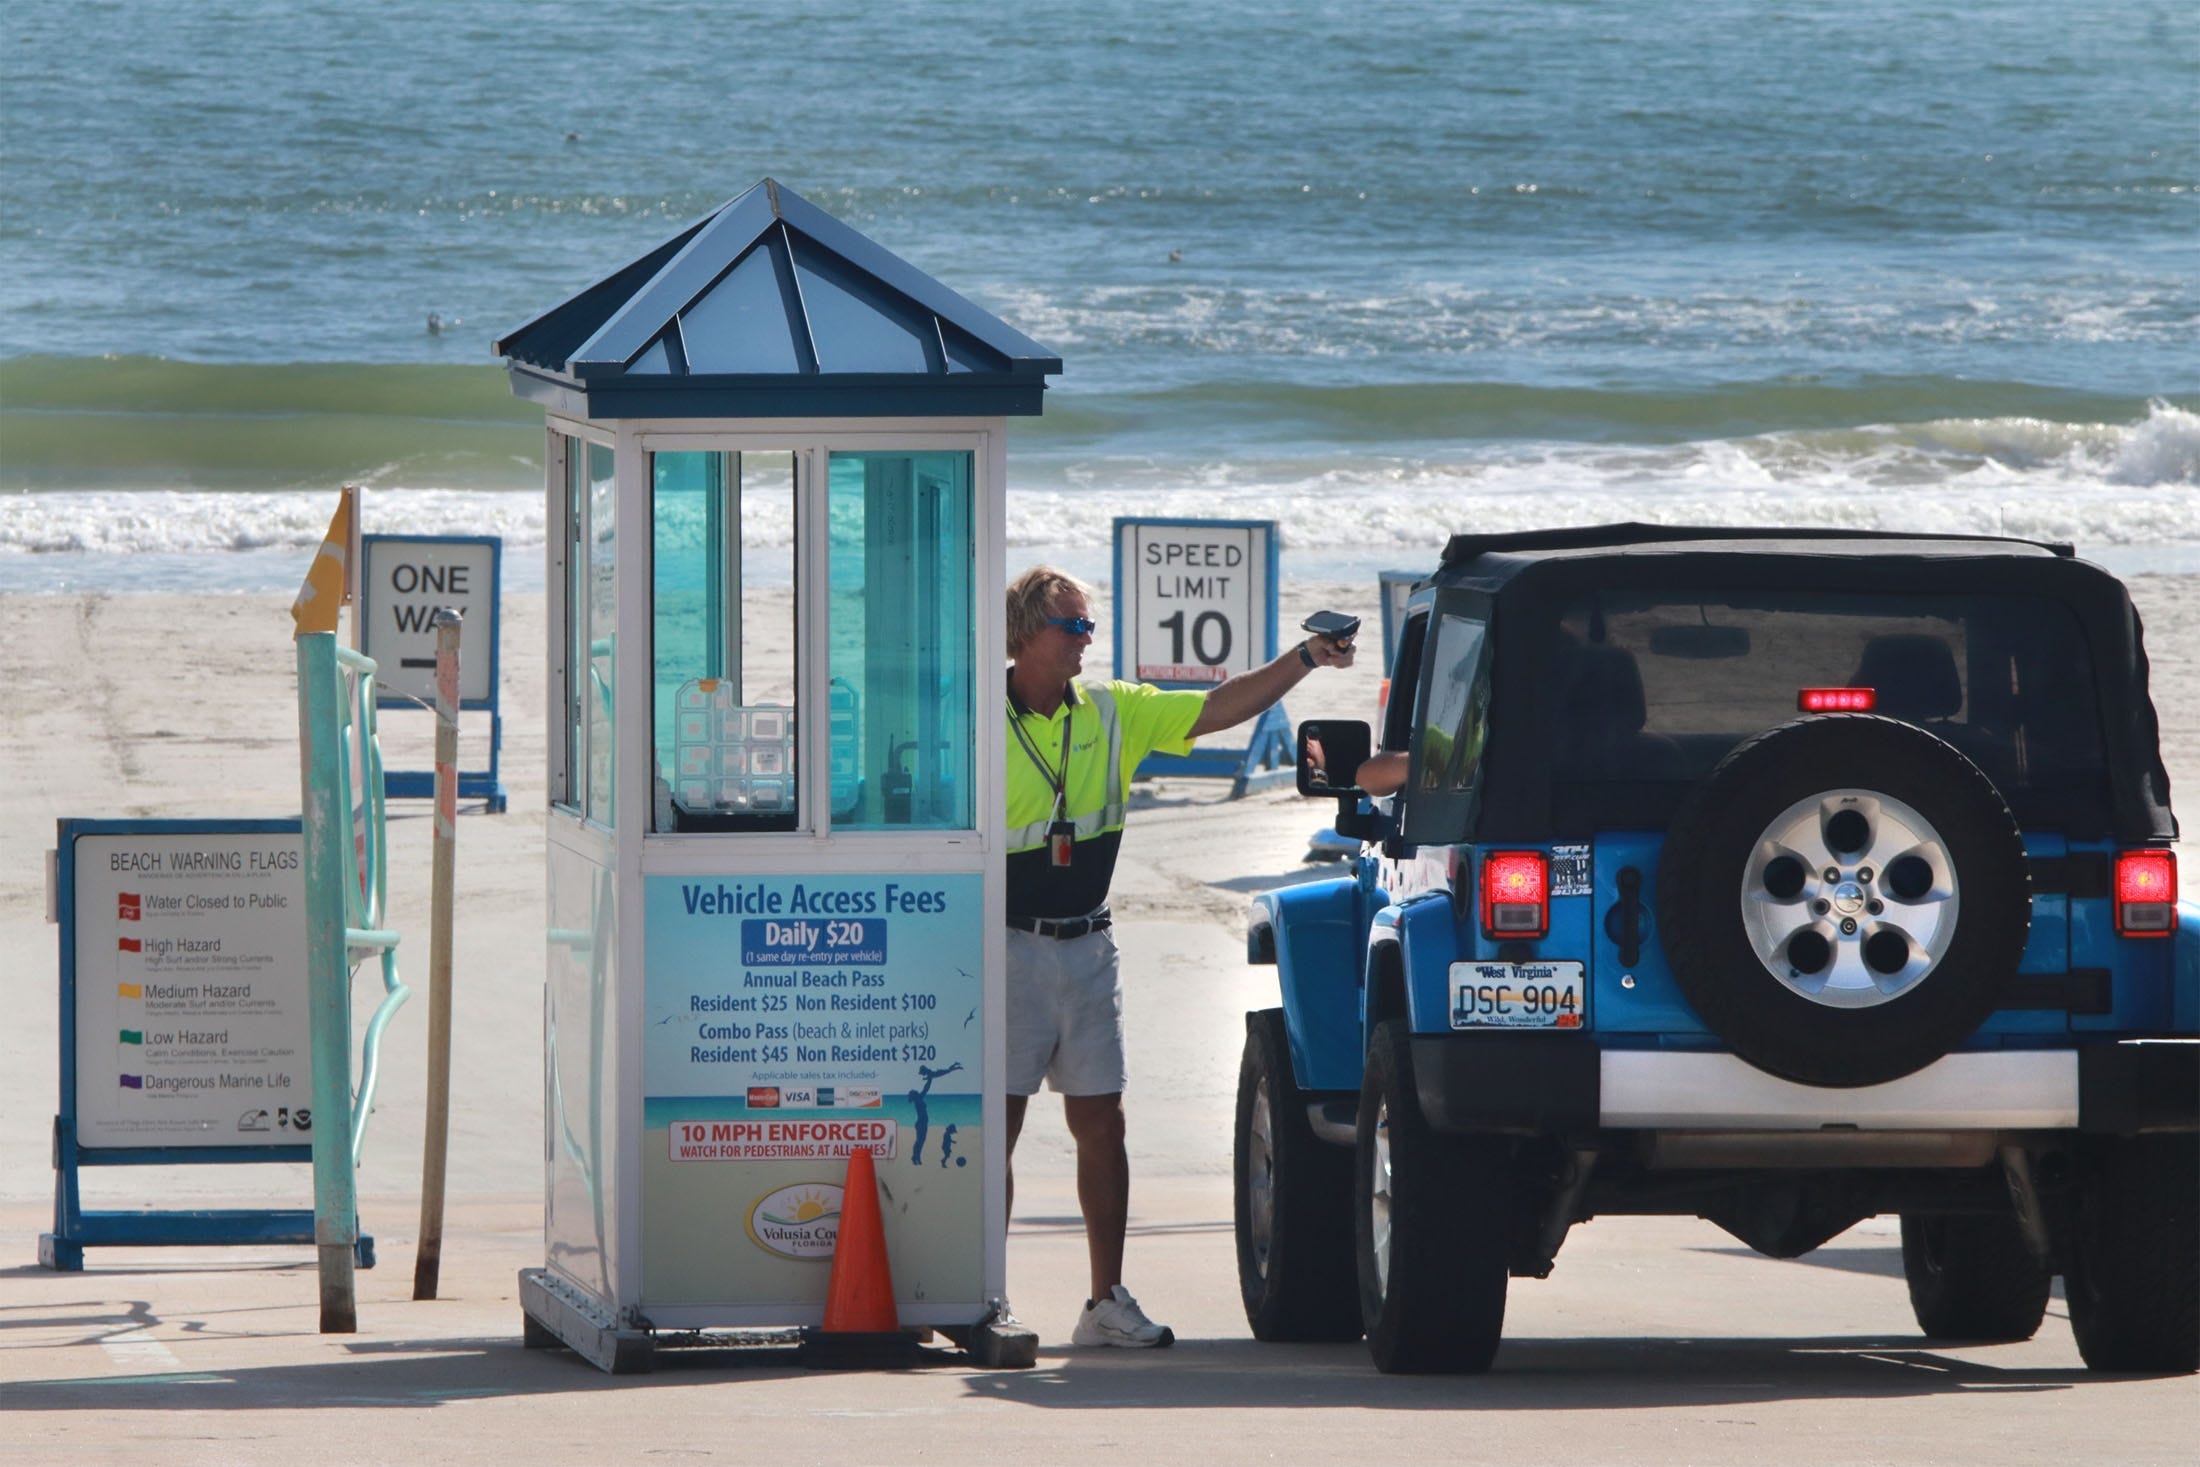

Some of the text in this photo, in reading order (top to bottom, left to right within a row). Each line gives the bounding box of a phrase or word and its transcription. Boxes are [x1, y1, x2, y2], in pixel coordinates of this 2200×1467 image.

[1146, 543, 1242, 567] SPEED
[392, 564, 470, 594] ONE
[1157, 575, 1230, 599] LIMIT
[1158, 610, 1232, 666] 10
[110, 851, 298, 871] BEACH WARNING FLAGS
[145, 893, 287, 909] Water Closed to Public
[682, 884, 946, 915] Vehicle Access Fees
[766, 920, 864, 951] Daily $20
[144, 938, 221, 956] High Hazard
[746, 950, 882, 964] (1 same day re-entry per vehicle)
[743, 970, 885, 988] Annual Beach Pass
[1481, 966, 1552, 980] West Virginia
[145, 984, 250, 999] Medium Hazard
[1460, 985, 1575, 1014] DSC 904
[690, 992, 937, 1013] Resident $25 Non Resident $100
[145, 1030, 228, 1045] Low Hazard
[699, 1021, 929, 1042] Combo Pass (beach & inlet parks)
[691, 1043, 936, 1064] Resident $45 Non Resident $120
[145, 1073, 291, 1092] Dangerous Marine Life
[752, 1070, 876, 1081] Applicable sales tax included
[785, 1091, 811, 1102] VISA
[681, 1123, 886, 1142] 10 MPH ENFORCED
[680, 1145, 717, 1158] WATCH
[720, 1145, 741, 1157] FOR
[744, 1144, 815, 1157] PEDESTRIANS
[817, 1144, 830, 1156] AT
[832, 1144, 851, 1156] ALL
[763, 1227, 811, 1241] Volusia
[792, 1240, 833, 1248] FLORIDA
